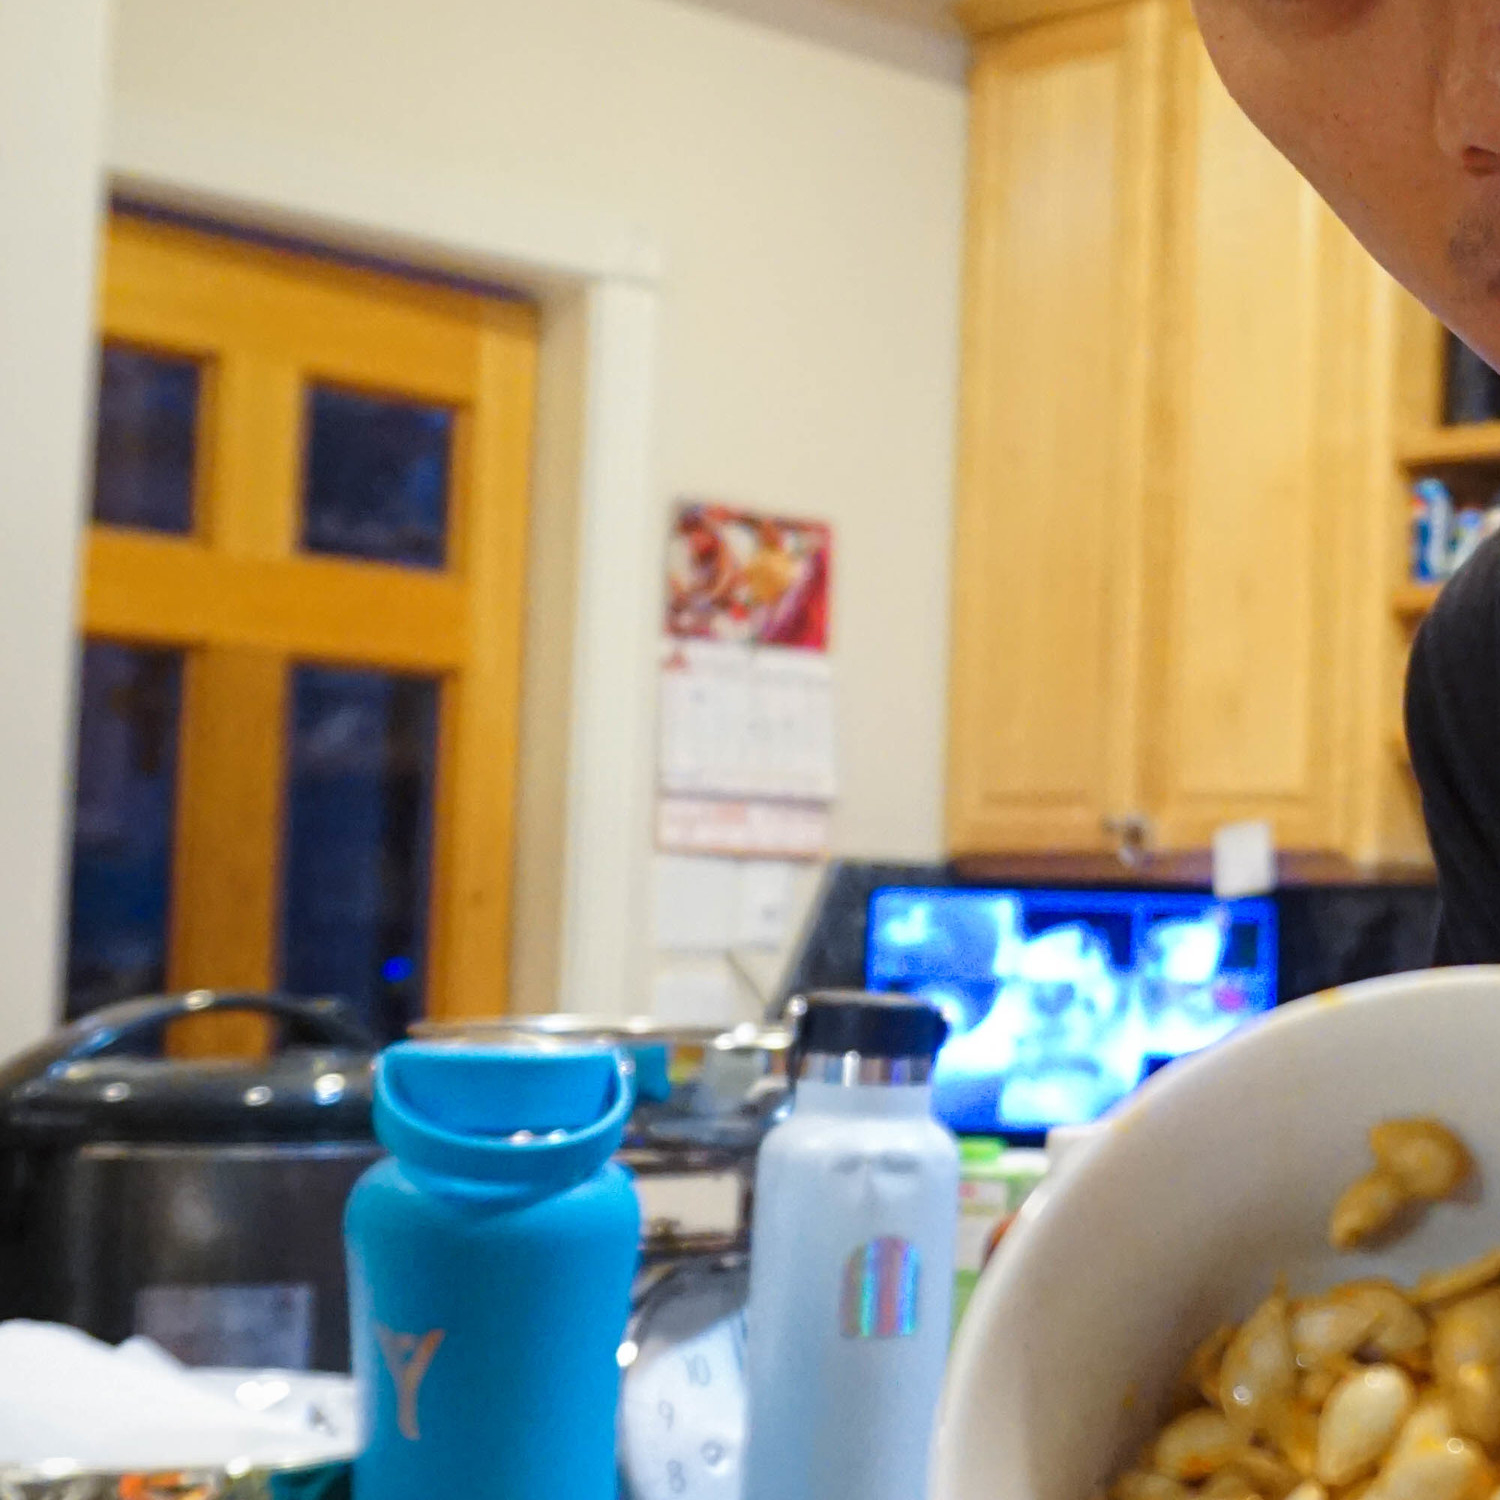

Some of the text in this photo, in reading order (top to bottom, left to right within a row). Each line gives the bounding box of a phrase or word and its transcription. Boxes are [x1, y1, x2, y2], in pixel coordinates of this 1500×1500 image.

[684, 1352, 711, 1387] 10
[657, 1399, 674, 1430] 9
[665, 1458, 687, 1493] 8
